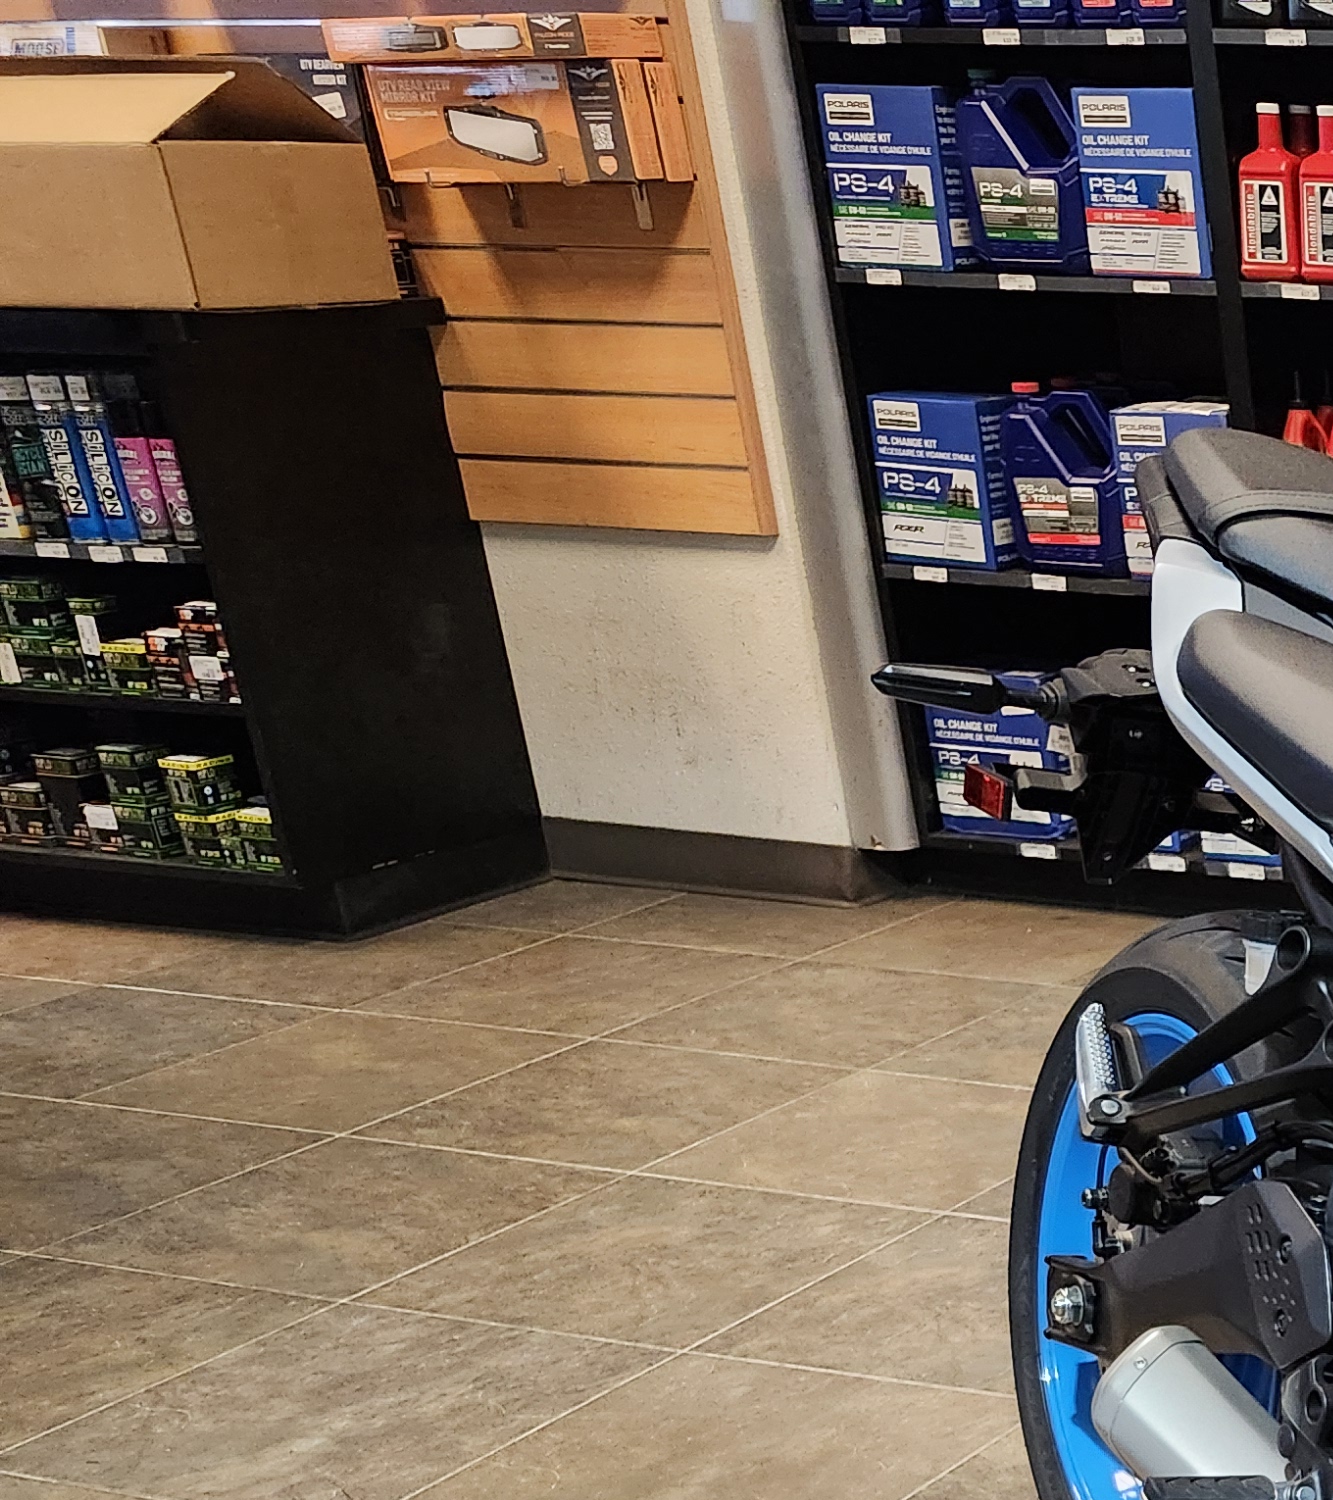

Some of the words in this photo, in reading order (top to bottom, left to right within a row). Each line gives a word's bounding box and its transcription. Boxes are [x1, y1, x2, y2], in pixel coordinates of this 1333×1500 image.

[378, 80, 396, 93] UTV
[397, 80, 422, 93] REAR
[424, 79, 450, 91] VIEW
[380, 90, 418, 103] MIRROR
[420, 90, 436, 101] KIT
[827, 100, 869, 109] POLARIS
[1082, 103, 1126, 112] POLARIS
[828, 131, 843, 142] OIL
[843, 132, 877, 143] CHANGE
[877, 132, 892, 144] KIT
[1082, 134, 1098, 145] OIL
[1098, 135, 1135, 145] CHANGE
[1135, 135, 1150, 145] KIT
[833, 172, 895, 194] PS-4
[1088, 177, 1138, 194] PS-4
[979, 182, 1023, 198] PS-4
[1090, 194, 1139, 204] EXTREME
[1246, 193, 1258, 253] Hondabrite
[1307, 195, 1319, 255] Hondabrite
[876, 408, 917, 418] POLARIS
[1118, 423, 1162, 432] POLARIS
[876, 435, 892, 446] OIL
[892, 436, 924, 448] CHANGE
[924, 438, 937, 449] KIT
[1119, 451, 1133, 462] OIL
[882, 471, 942, 494] PS-4
[1018, 484, 1048, 494] PS-4
[933, 718, 948, 728] OIL
[947, 719, 983, 731] CHANGE
[983, 723, 998, 733] KIT
[938, 750, 980, 765] PS-4
